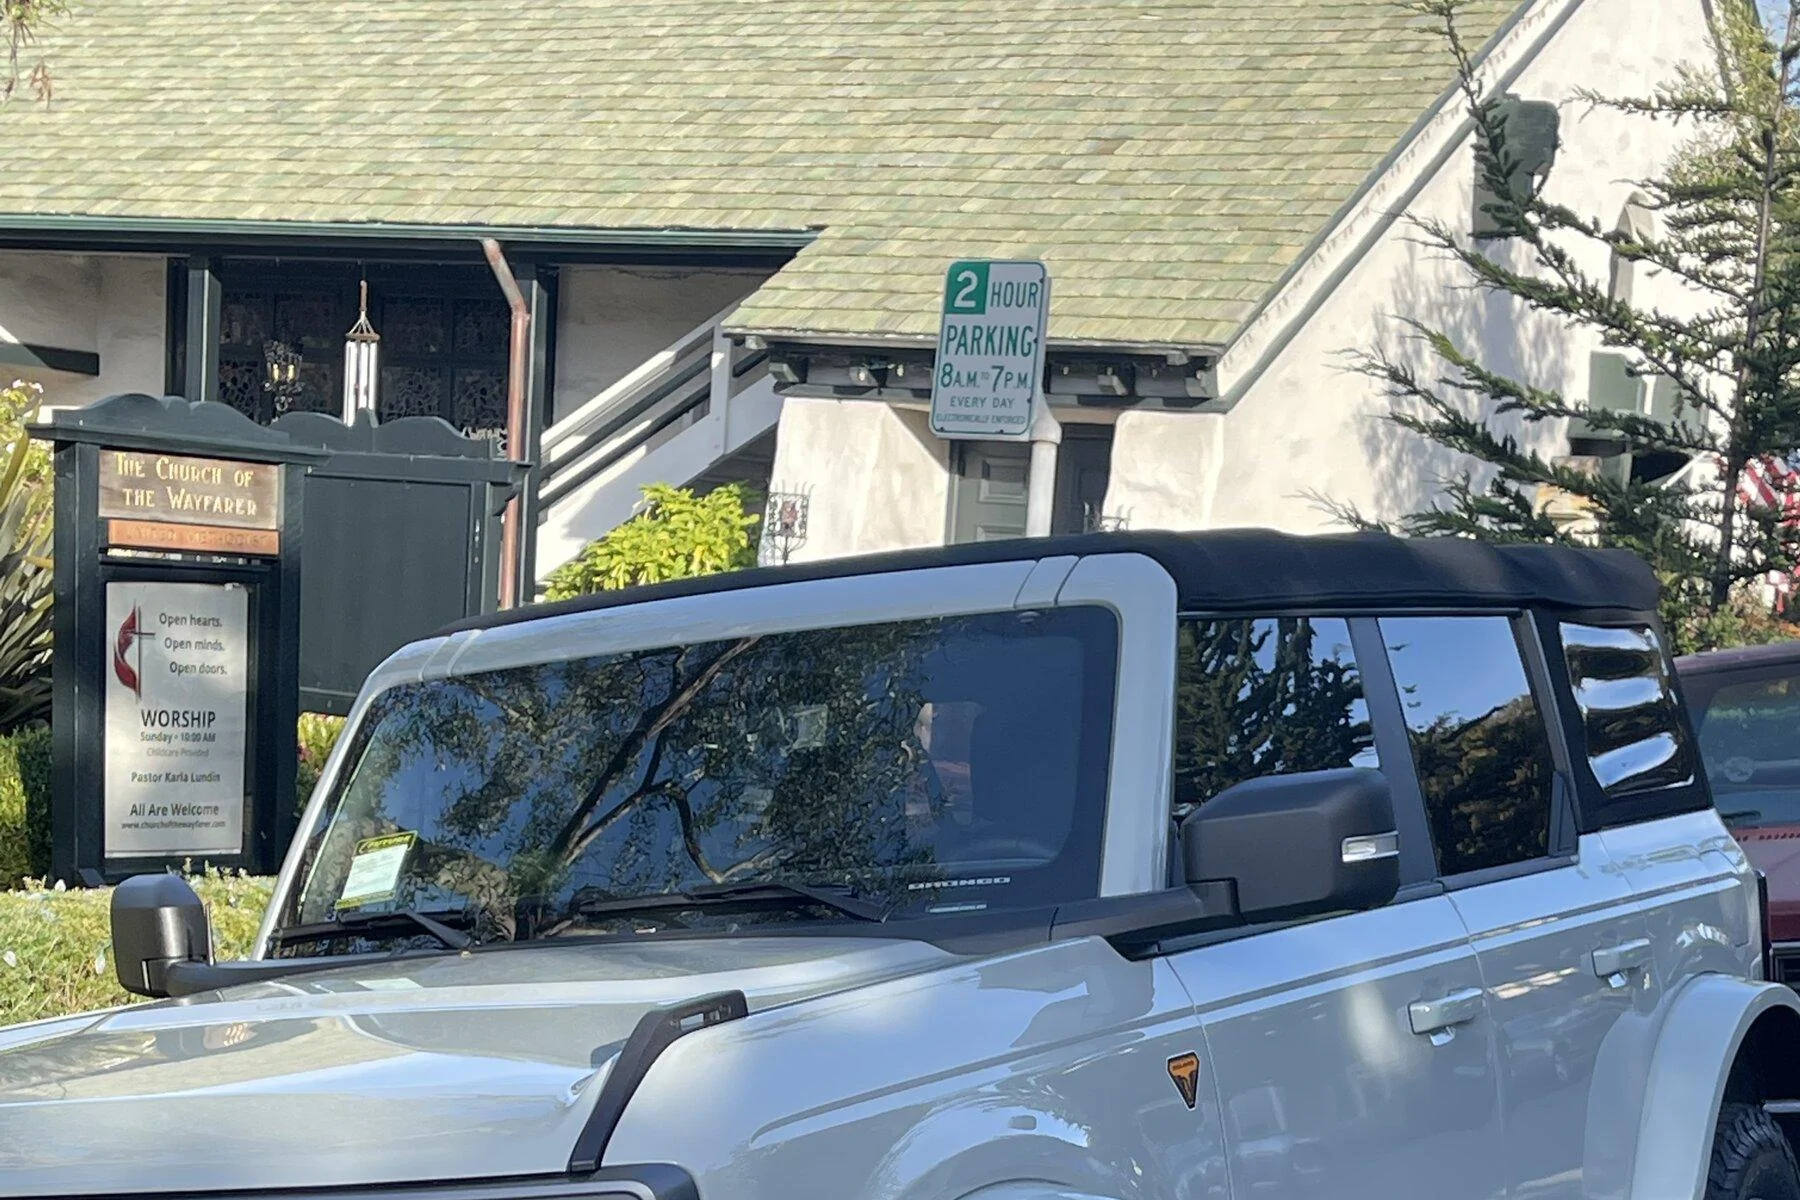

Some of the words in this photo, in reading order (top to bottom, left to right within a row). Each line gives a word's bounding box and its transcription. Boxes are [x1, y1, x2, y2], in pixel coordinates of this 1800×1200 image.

[953, 270, 979, 308] 2
[990, 281, 1039, 308] HOUR
[944, 325, 1034, 357] PARKING
[950, 396, 987, 409] EVERY
[992, 397, 1016, 409] DAY
[156, 457, 222, 485] CHURCH
[233, 470, 254, 488] OF
[123, 488, 155, 508] THE
[166, 486, 258, 516] WAYFARER
[159, 612, 187, 627] Open
[190, 613, 223, 628] hearts.
[164, 636, 192, 652] Open
[194, 638, 225, 651] minds.
[169, 661, 196, 676] Open
[198, 662, 227, 675] doors.
[140, 708, 217, 729] WORSHIP
[140, 731, 173, 744] Sunday
[202, 732, 217, 742] AM
[131, 771, 163, 783] Pastor
[129, 803, 146, 816] All
[147, 803, 169, 816] Are
[170, 803, 220, 816] Welcome
[907, 876, 1011, 891] BRONCO
